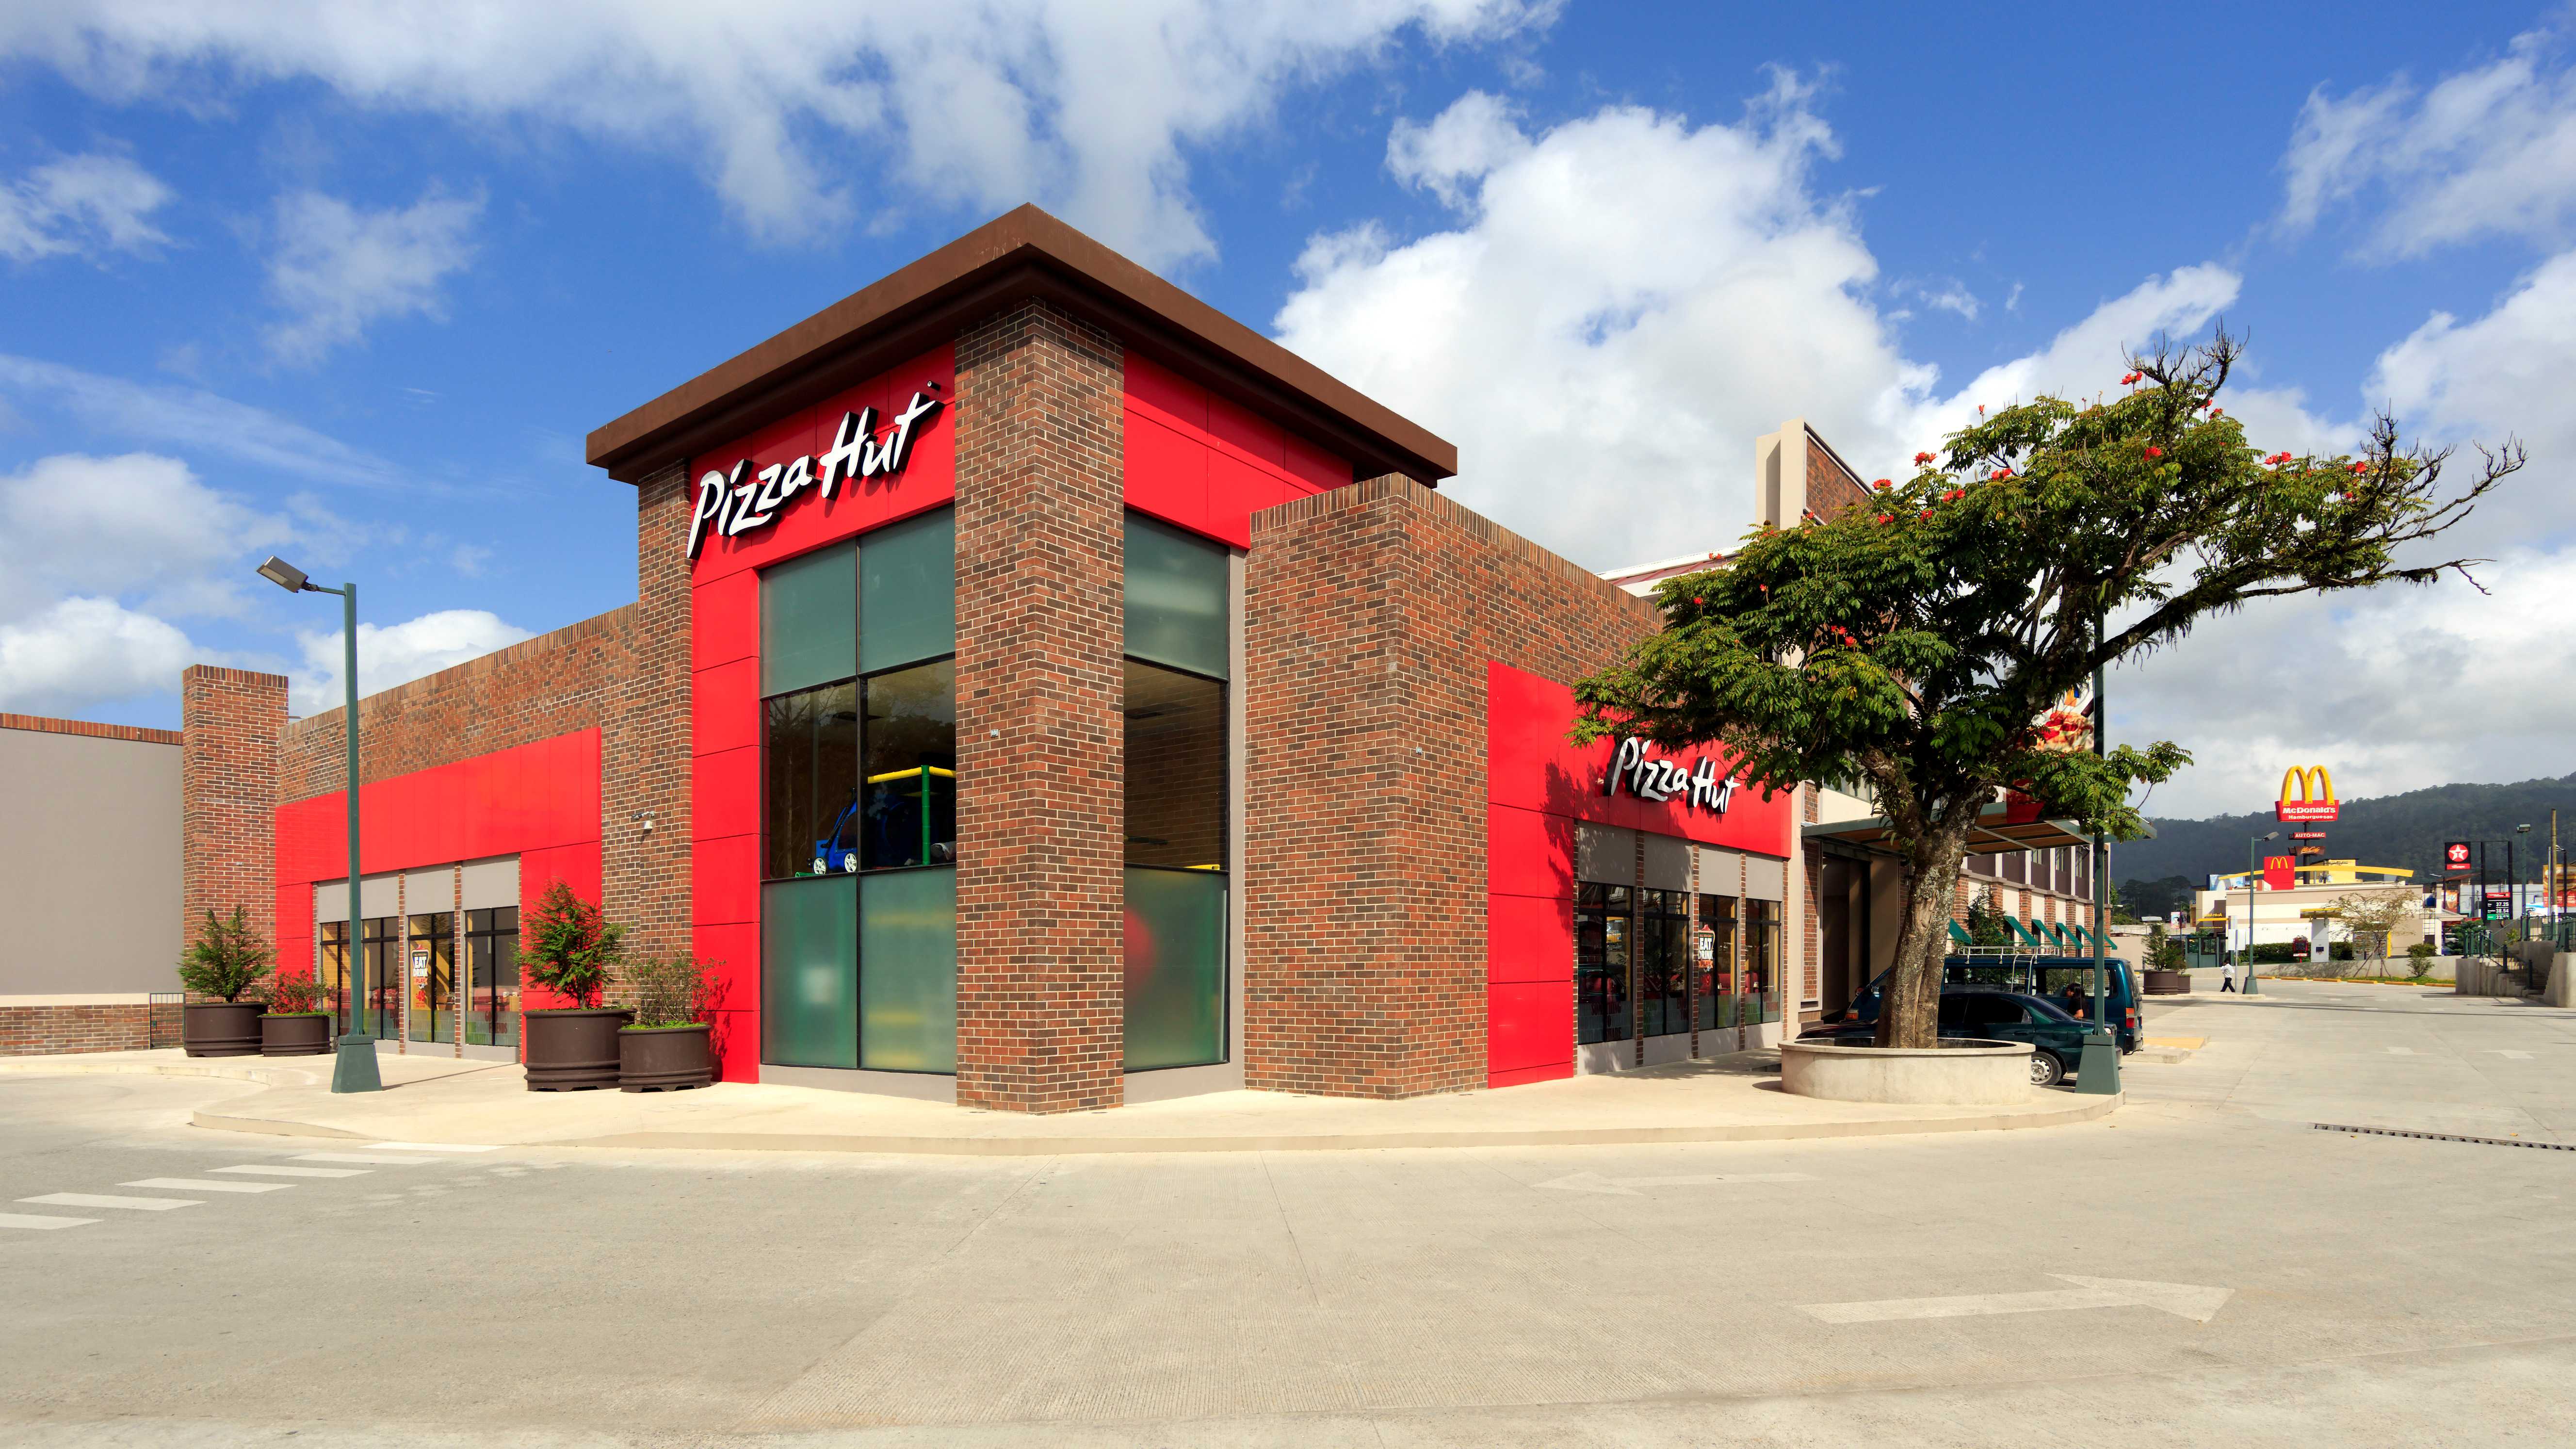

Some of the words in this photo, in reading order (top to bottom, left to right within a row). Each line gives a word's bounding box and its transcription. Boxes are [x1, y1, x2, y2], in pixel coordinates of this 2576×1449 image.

[686, 455, 813, 558] Pizza
[819, 391, 936, 499] Hut
[1611, 736, 1689, 802] Pizza
[1692, 756, 1741, 814] Hut
[414, 956, 427, 968] EAT
[1699, 937, 1712, 950] EAT
